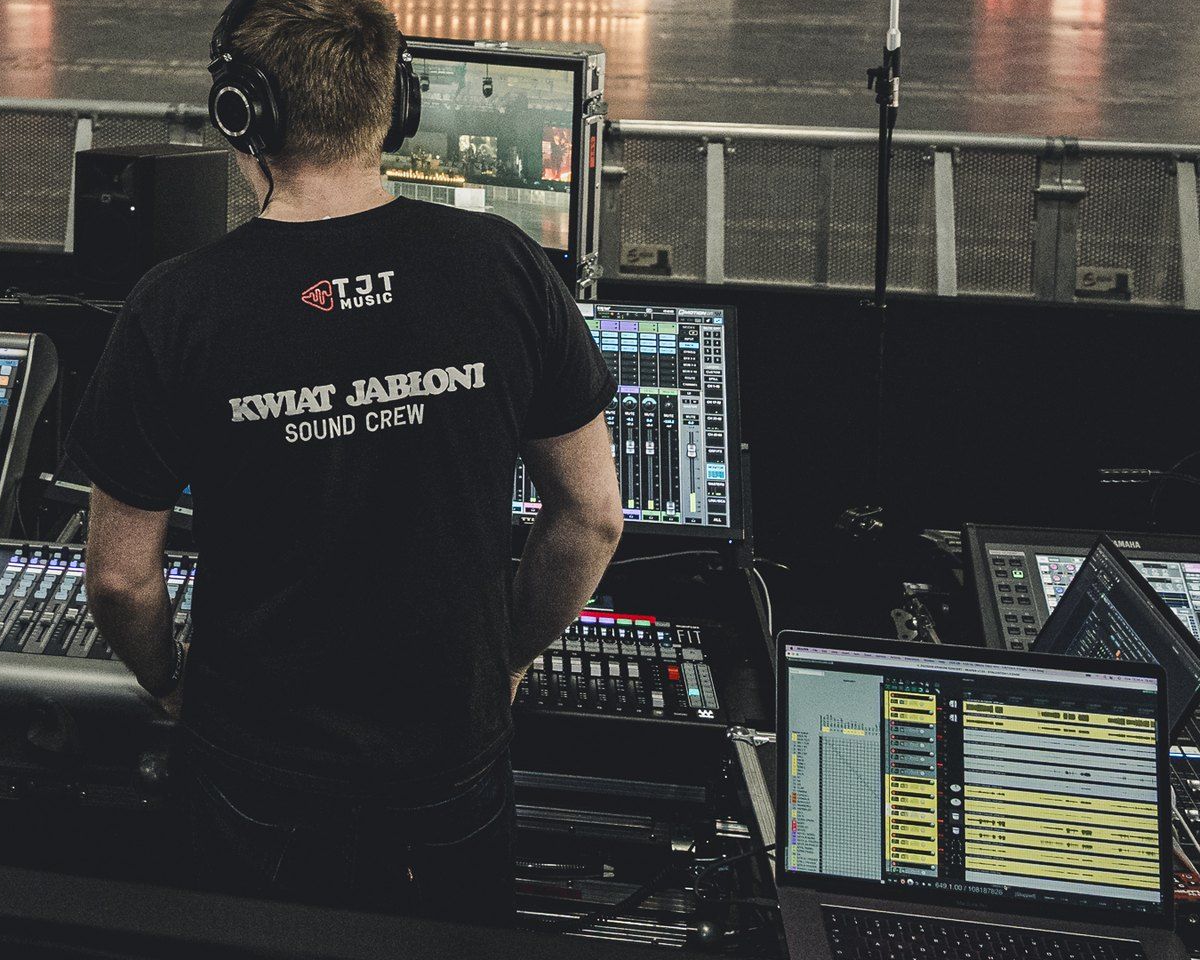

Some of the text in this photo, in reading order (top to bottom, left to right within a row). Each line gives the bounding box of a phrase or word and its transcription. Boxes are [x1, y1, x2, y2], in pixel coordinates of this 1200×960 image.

[332, 270, 395, 298] TJT
[340, 292, 393, 310] MUSIC
[228, 362, 486, 422] KWIAT JABŁONI
[285, 404, 425, 443] SOUND CREW
[1111, 539, 1142, 550] AMAHA
[675, 629, 701, 645] FIT
